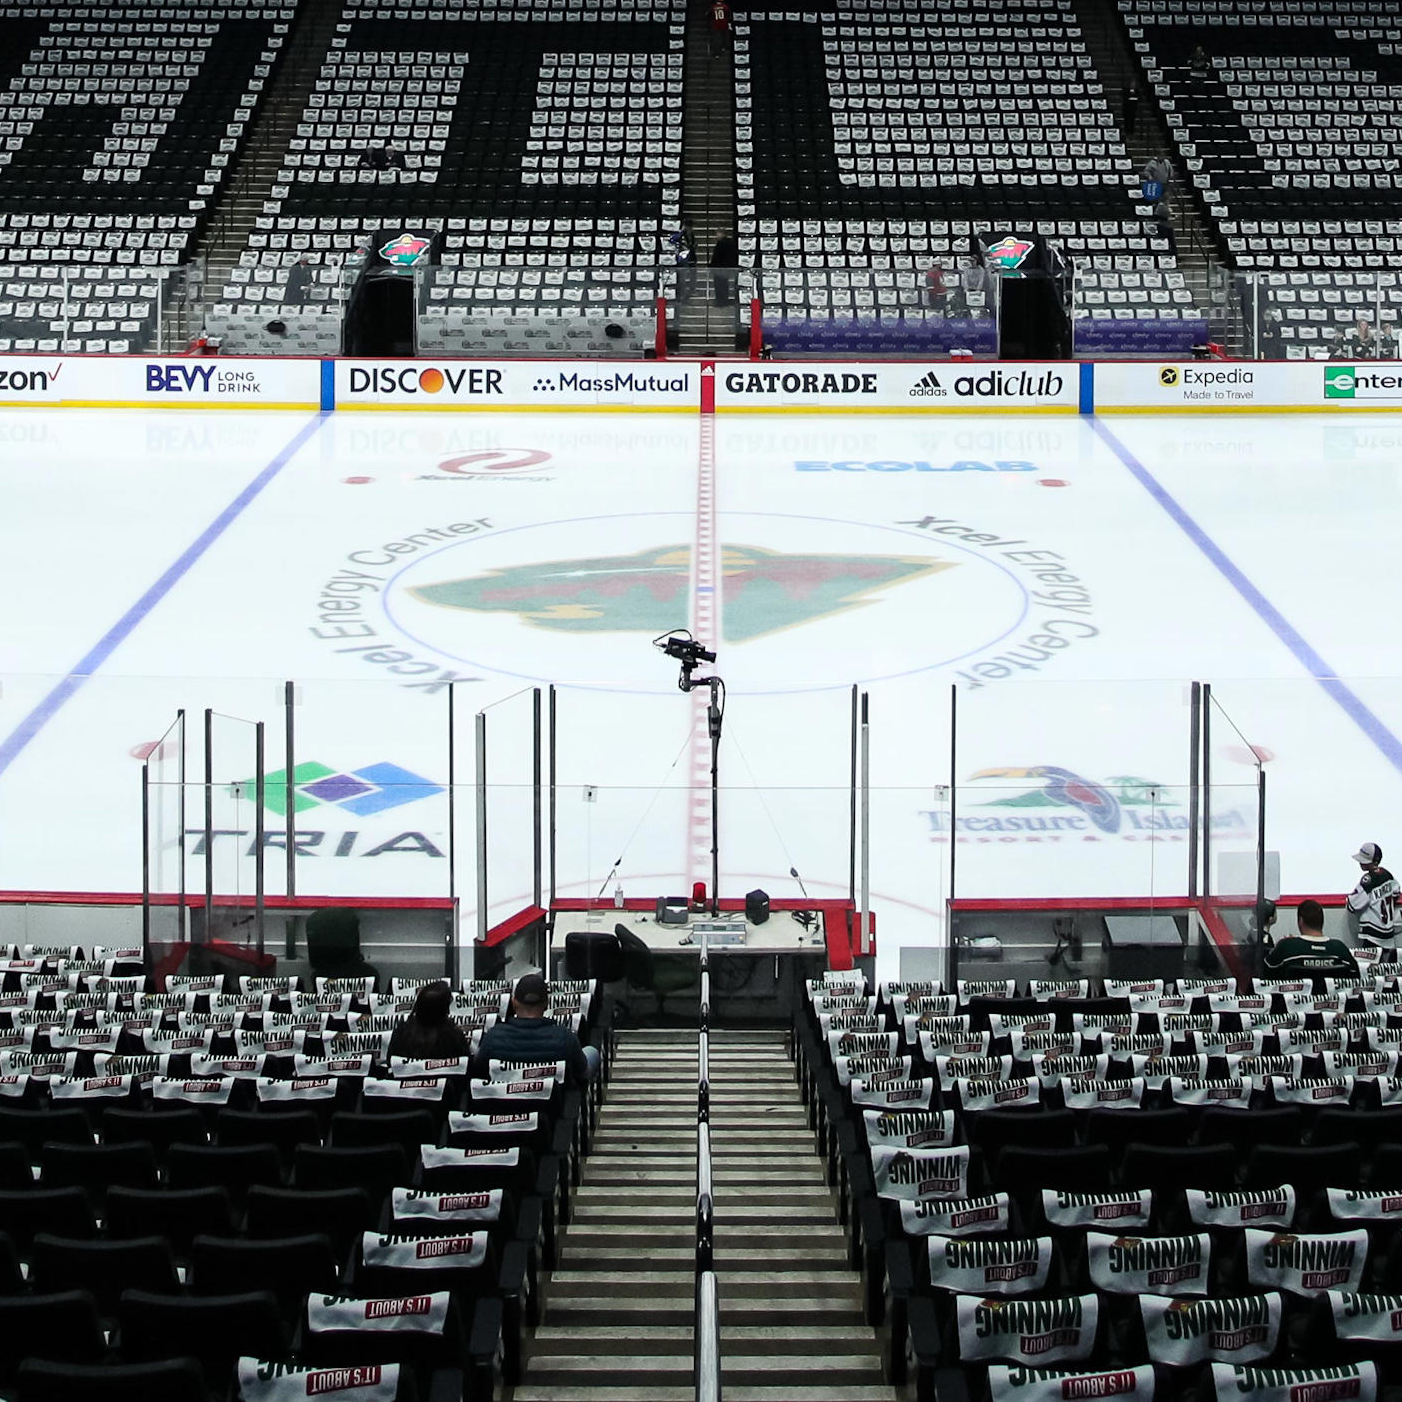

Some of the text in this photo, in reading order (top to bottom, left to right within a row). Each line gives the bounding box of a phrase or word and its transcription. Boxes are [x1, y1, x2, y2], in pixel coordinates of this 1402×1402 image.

[146, 365, 217, 392] BEVY
[218, 372, 255, 382] LONG
[350, 368, 504, 395] DISCOVER
[559, 372, 688, 392] MassMutual
[726, 373, 878, 393] GATORADE
[909, 370, 1063, 397] adidas adiclub
[1183, 369, 1254, 387] Expedia
[218, 383, 261, 393] DRINK
[1183, 390, 1254, 399] Made to Travel
[794, 461, 1038, 472] ECOLAB
[309, 517, 493, 695] Xcel Energy Center
[895, 516, 1099, 690] Xcel Energy Center
[918, 811, 1088, 832] Treasure
[183, 829, 447, 858] TRIA
[421, 1239, 471, 1257] IT'S ABOUT
[369, 1298, 427, 1317] IT'S ABOUT
[311, 1367, 377, 1392] IT'S ABOUT
[1066, 1373, 1132, 1399] IT'S ABOUT
